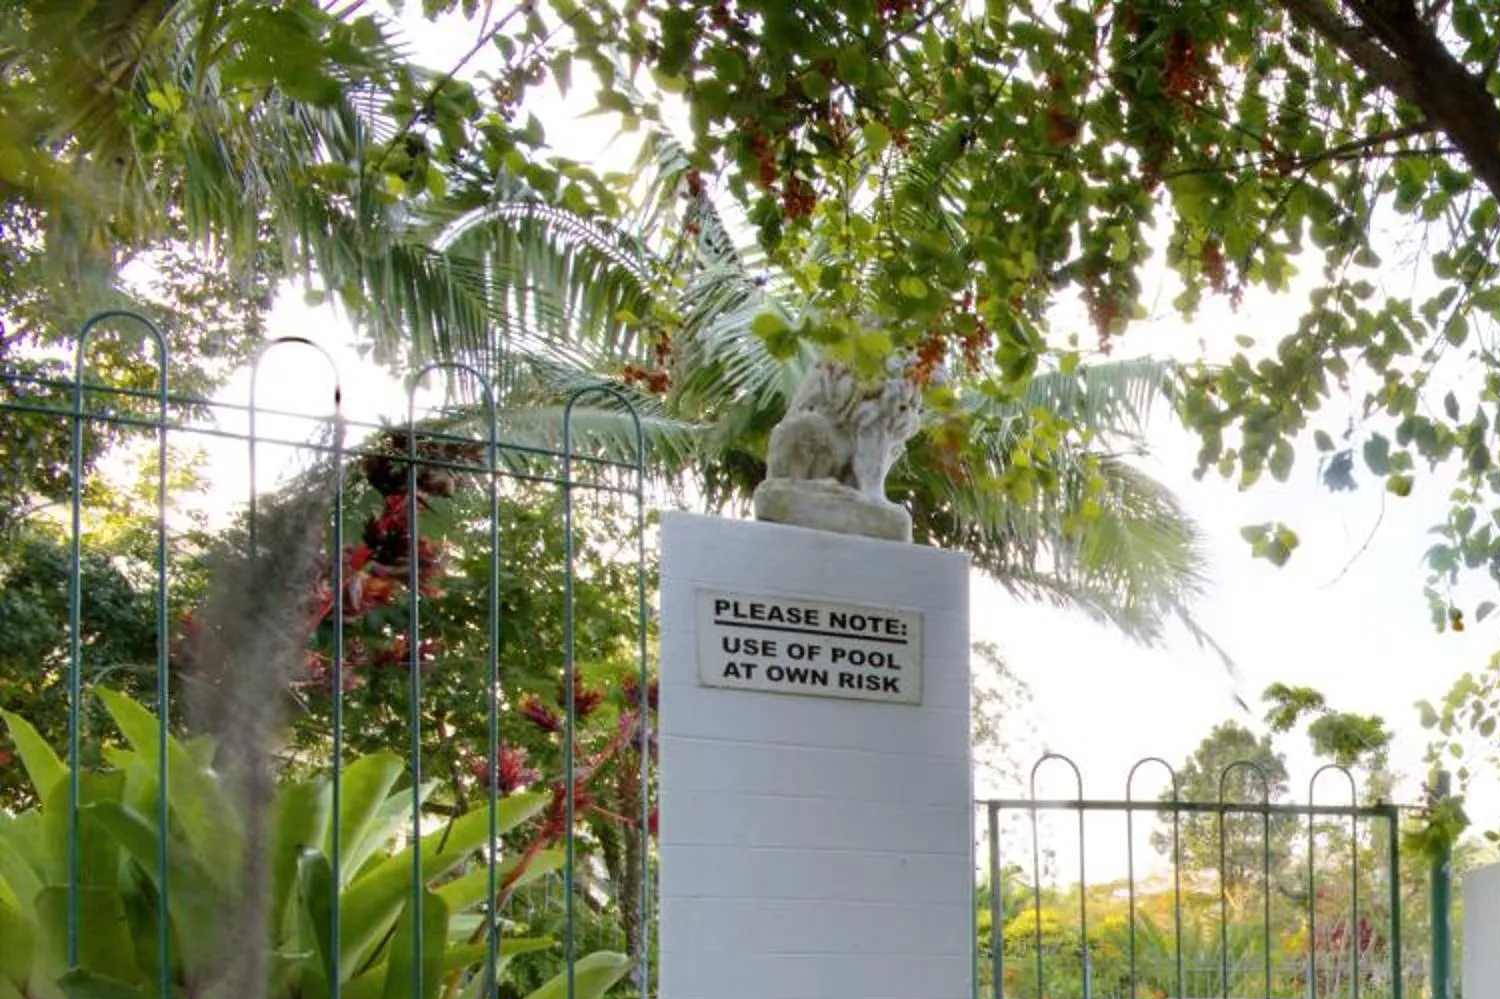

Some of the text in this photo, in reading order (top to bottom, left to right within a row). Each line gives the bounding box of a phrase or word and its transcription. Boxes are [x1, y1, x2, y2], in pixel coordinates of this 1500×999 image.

[715, 599, 907, 636] PLEASE NOTE:
[722, 636, 902, 670] USE OF POOL
[723, 661, 900, 694] AT OWN RISK
